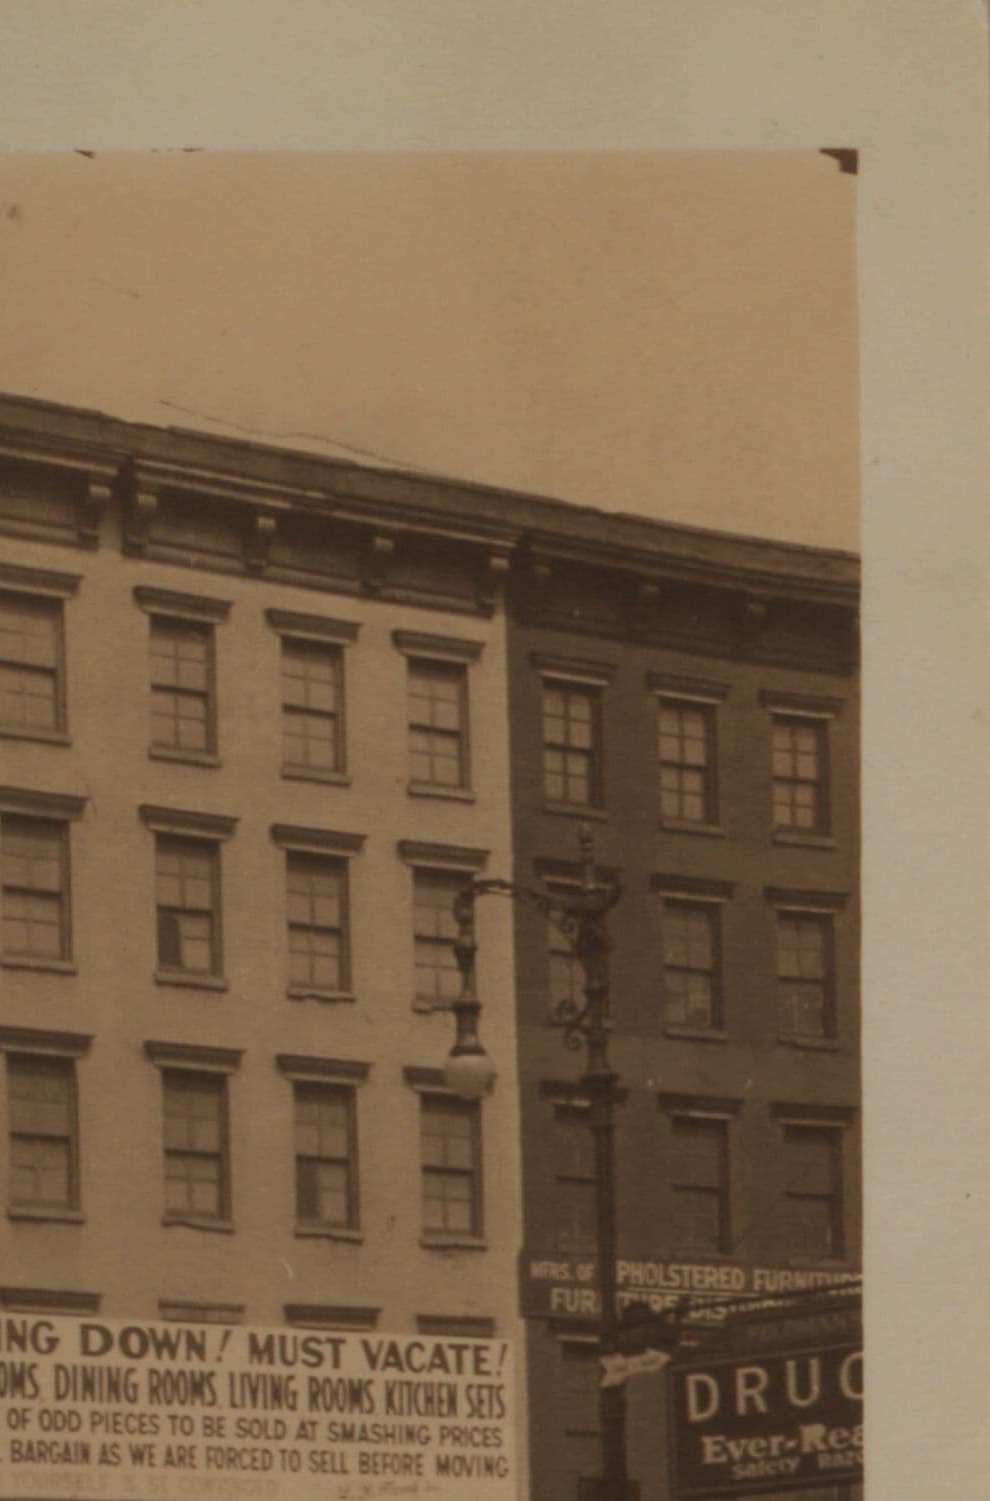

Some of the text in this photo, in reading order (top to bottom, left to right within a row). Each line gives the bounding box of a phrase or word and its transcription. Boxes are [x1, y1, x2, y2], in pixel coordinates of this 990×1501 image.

[614, 1260, 745, 1291] PHOLSTERED
[248, 1332, 347, 1370] MUST
[360, 1339, 508, 1377] VACATE!
[53, 1363, 139, 1405] DINING
[228, 1371, 298, 1411] LIVING
[384, 1380, 458, 1418] KITCHEN
[464, 1383, 506, 1420] SETS
[6, 1407, 32, 1431] OF
[38, 1408, 83, 1433] ODD
[90, 1410, 160, 1436] PIECES
[167, 1414, 195, 1437] TO
[203, 1415, 226, 1438] BE
[235, 1417, 287, 1441] SOLD
[296, 1420, 320, 1442] AT
[327, 1422, 432, 1446] SMASHING
[439, 1425, 503, 1448] PRICES
[10, 1439, 92, 1465] BARGAIN
[97, 1441, 122, 1467] AS
[127, 1442, 156, 1468] WE
[163, 1444, 198, 1469] ARE
[206, 1447, 273, 1472] FORCED
[279, 1448, 302, 1473] TO
[309, 1450, 349, 1475] SELL
[359, 1452, 424, 1477] BEFORE
[435, 1454, 510, 1478] MOVING
